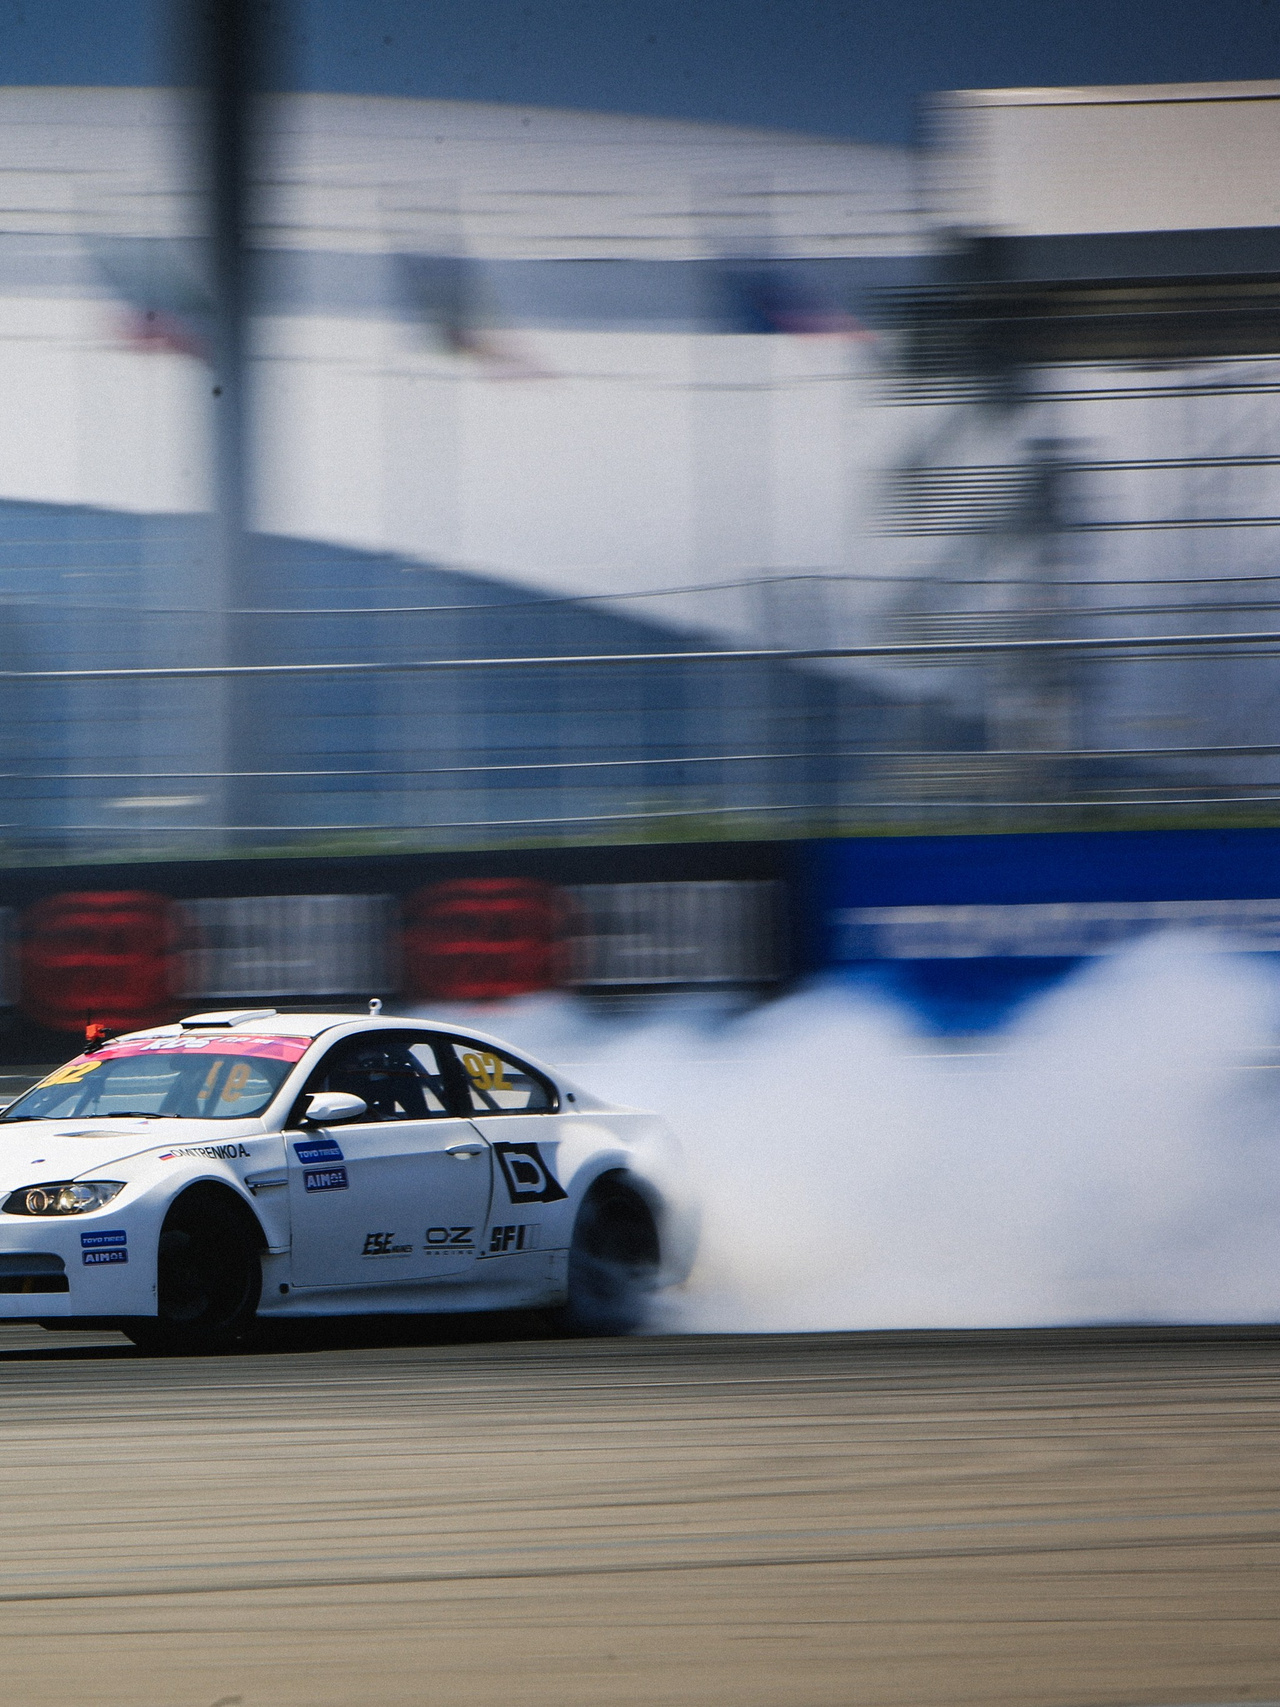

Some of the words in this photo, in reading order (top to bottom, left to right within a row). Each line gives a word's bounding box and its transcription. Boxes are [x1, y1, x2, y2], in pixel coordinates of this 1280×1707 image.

[36, 1060, 103, 1090] 92
[462, 1052, 513, 1091] 92
[298, 1150, 319, 1159] TOYO
[307, 1172, 347, 1188] AIMOL
[85, 1252, 125, 1263] AIMOL
